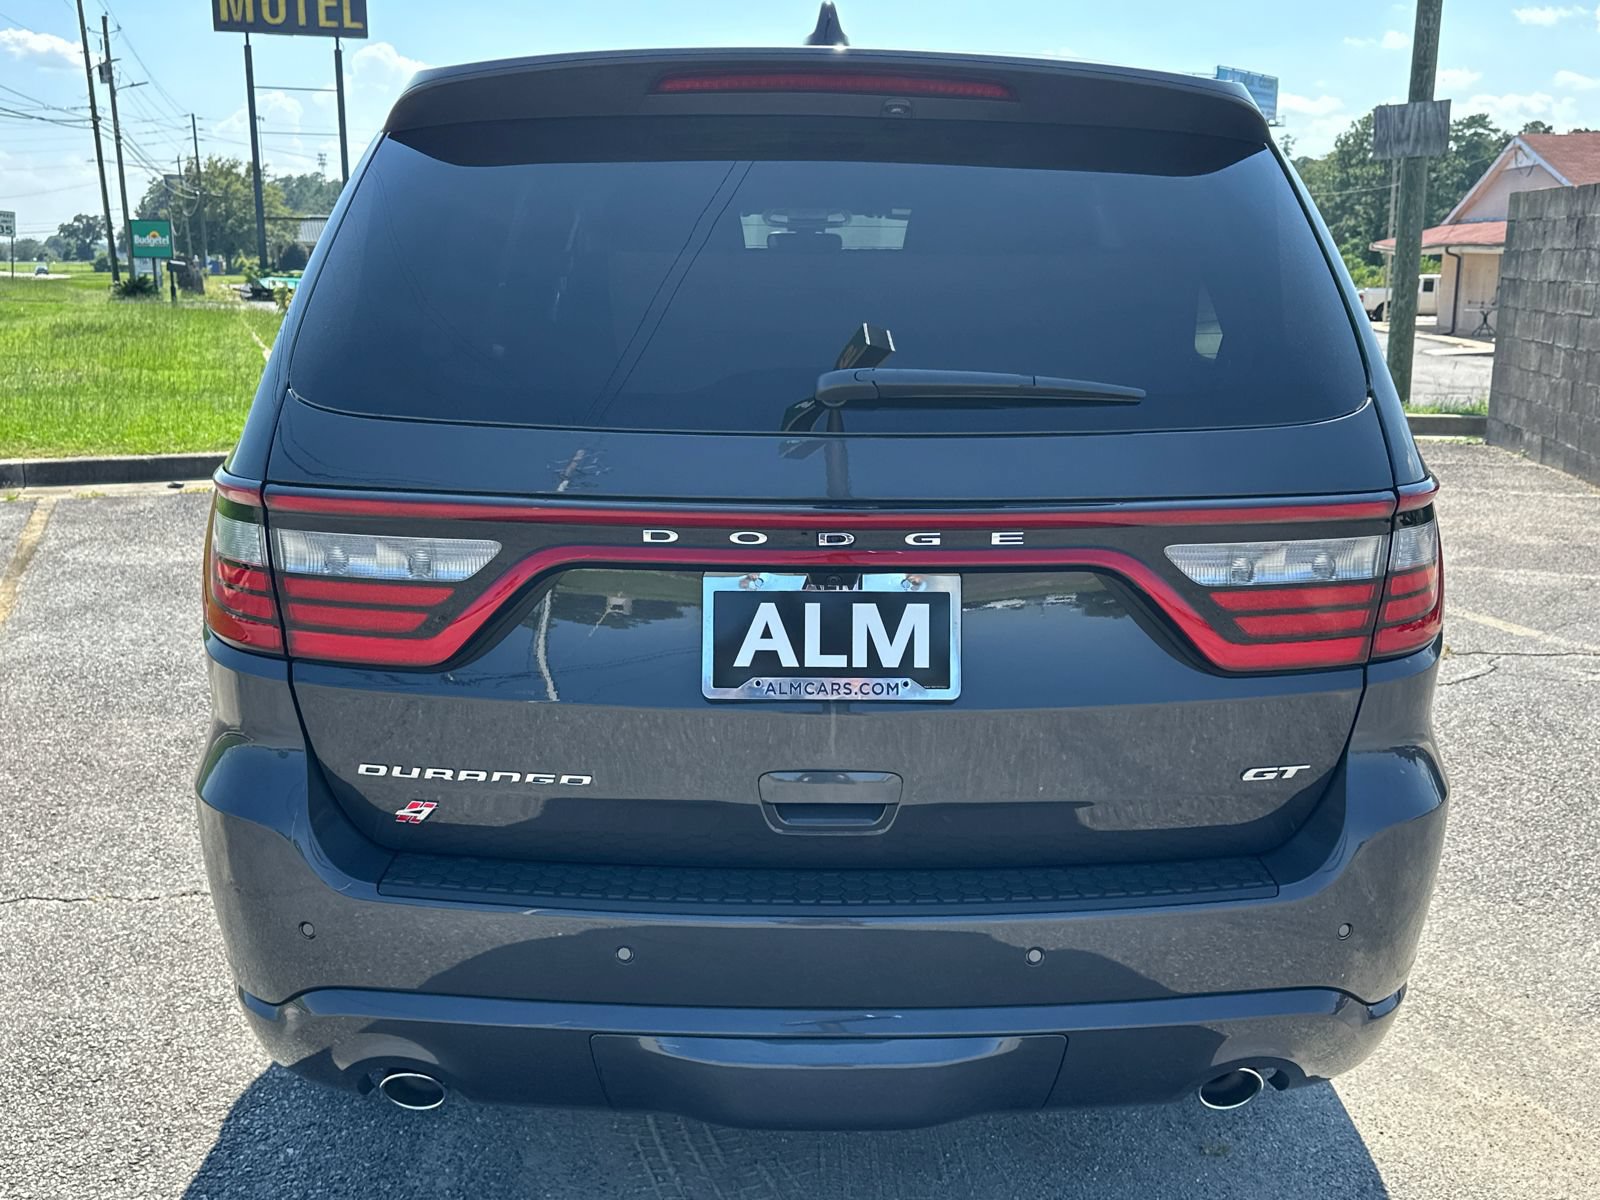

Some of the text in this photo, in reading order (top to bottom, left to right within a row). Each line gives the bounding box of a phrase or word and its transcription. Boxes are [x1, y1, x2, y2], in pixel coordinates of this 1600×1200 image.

[642, 529, 1024, 546] DODGE
[733, 602, 930, 669] ALM
[764, 682, 899, 696] ALMCARS.COM
[357, 763, 593, 786] DURANGO
[1242, 765, 1311, 781] GT
